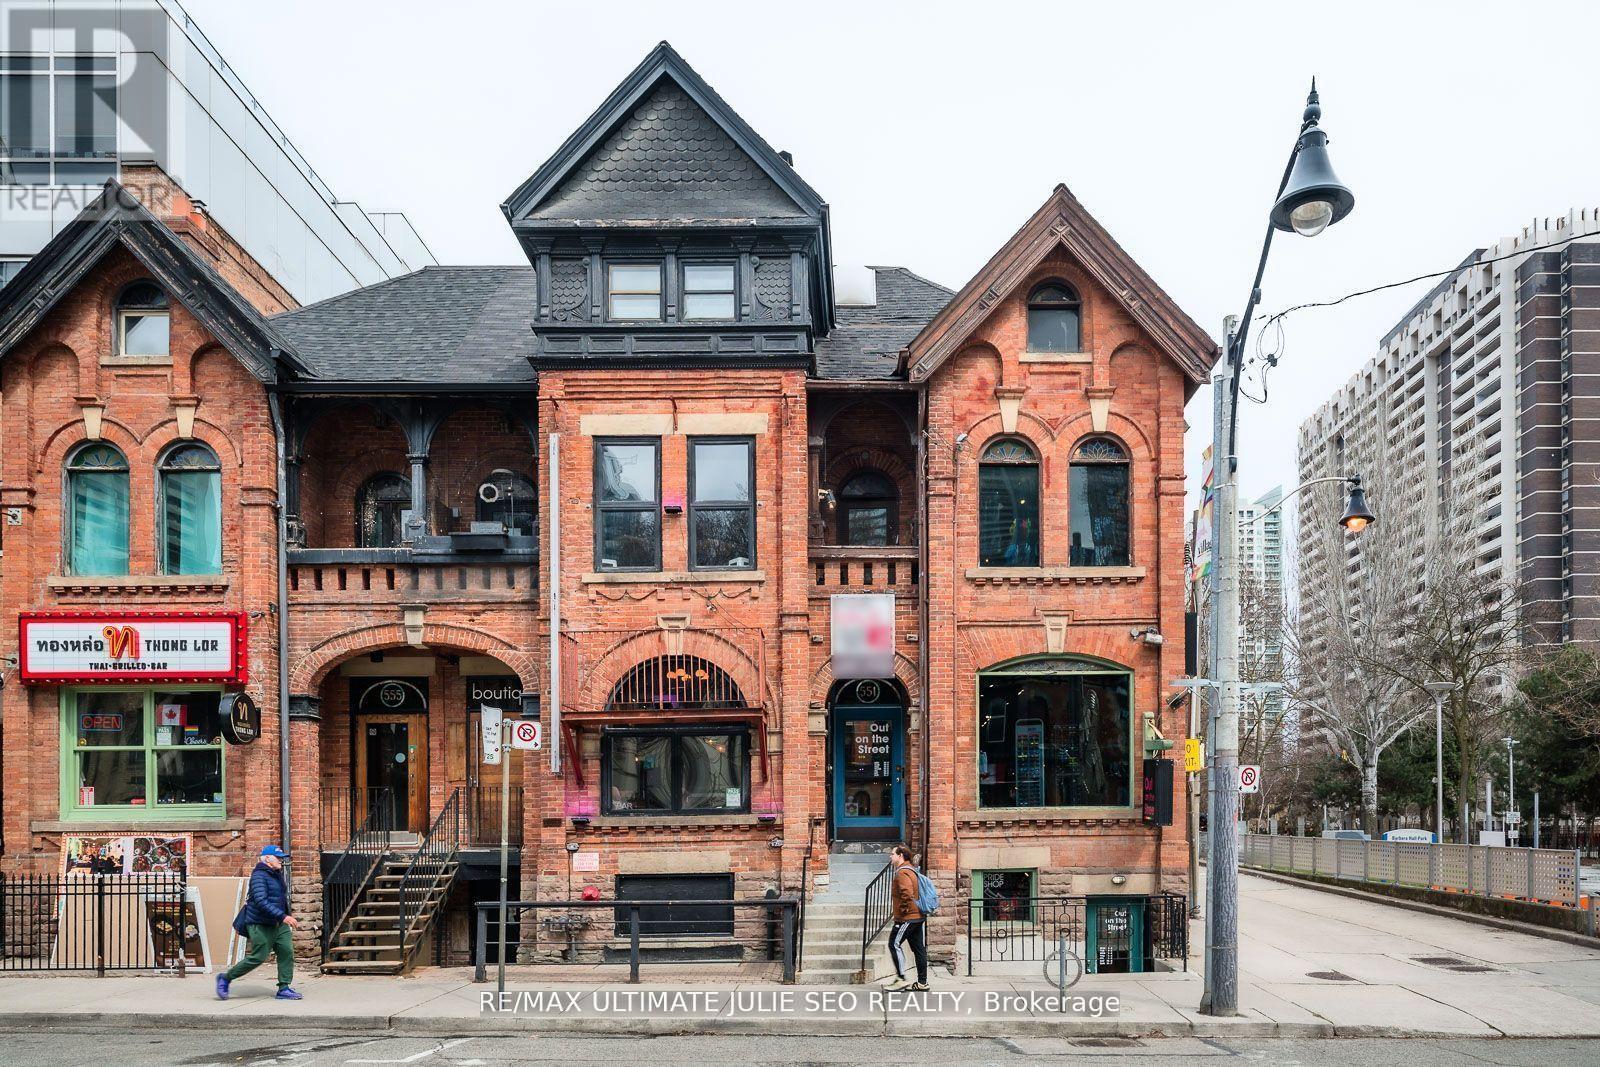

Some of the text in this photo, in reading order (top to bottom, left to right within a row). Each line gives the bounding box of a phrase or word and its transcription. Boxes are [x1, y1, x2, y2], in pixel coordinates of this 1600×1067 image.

[36, 635, 104, 652] ทองหล่อ
[144, 639, 219, 652] THONG LOR
[383, 689, 402, 701] 555
[859, 686, 876, 697] 551
[82, 716, 121, 729] OPEN
[870, 723, 889, 732] Out
[855, 734, 889, 744] on the
[858, 745, 889, 754] Street
[984, 873, 1004, 881] PRIDE
[984, 880, 1004, 888] SHOP
